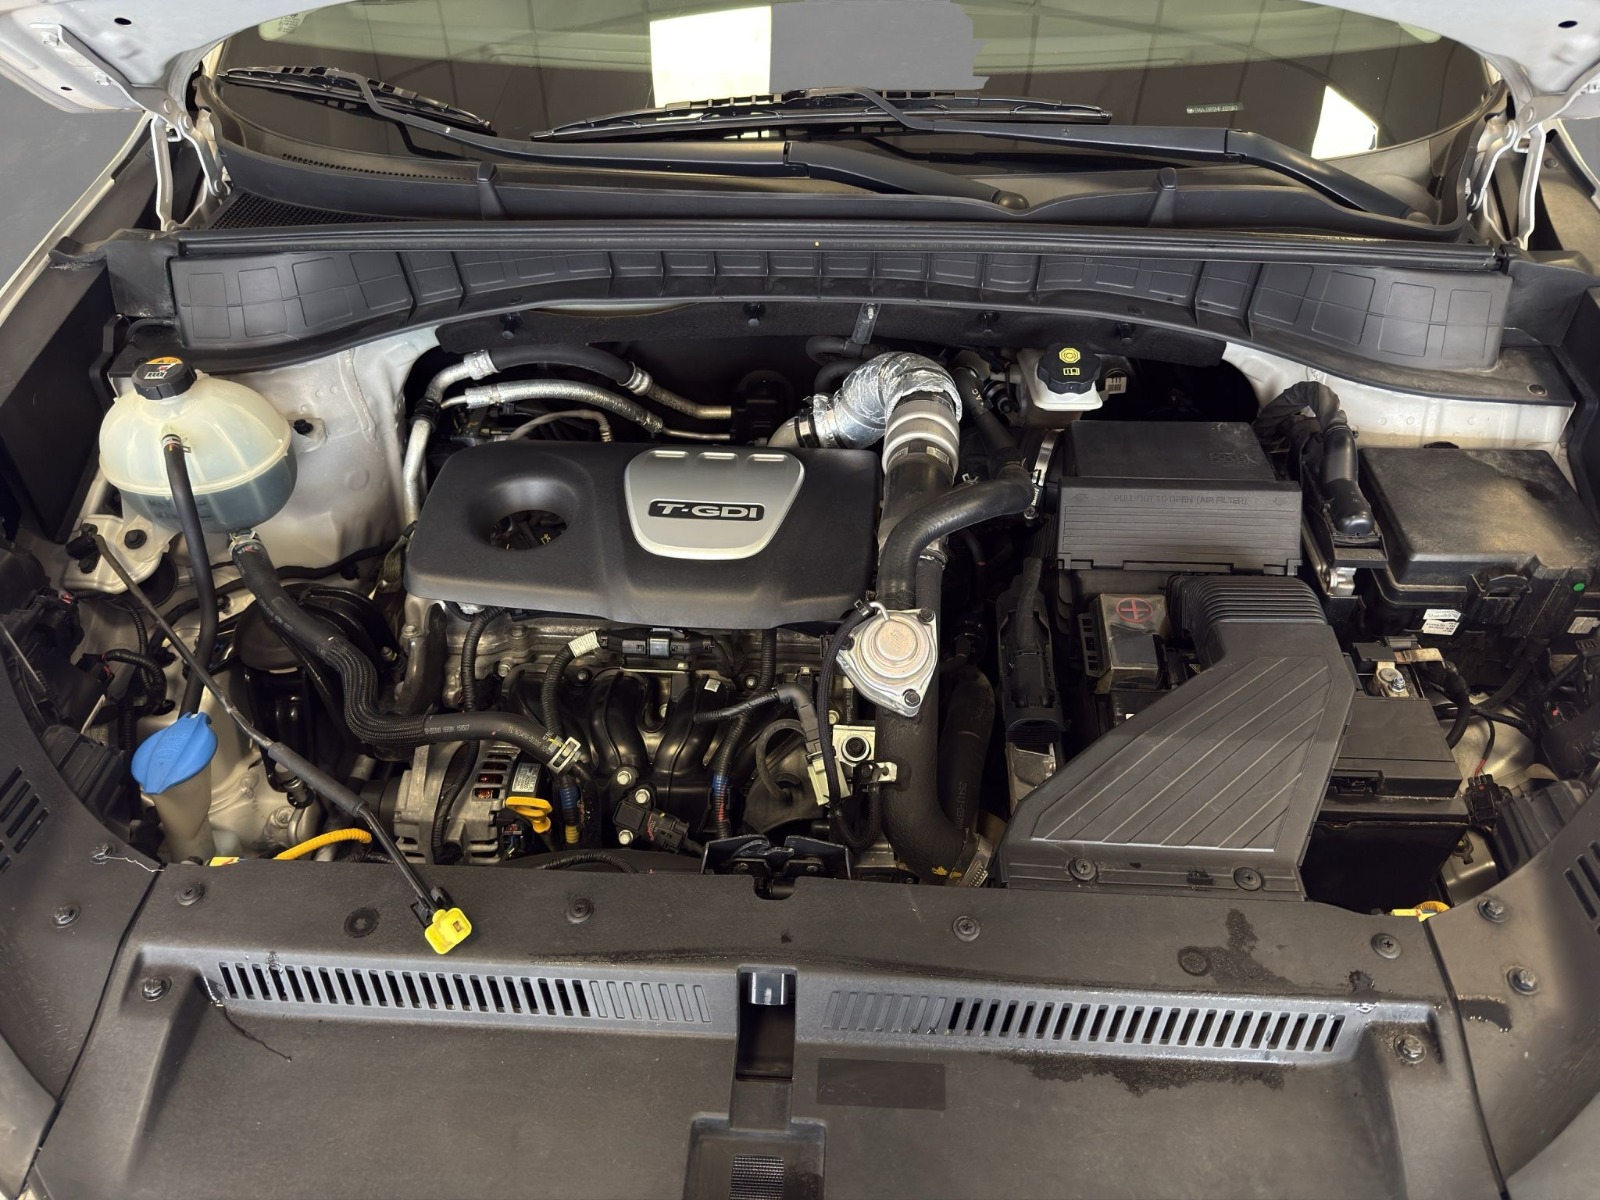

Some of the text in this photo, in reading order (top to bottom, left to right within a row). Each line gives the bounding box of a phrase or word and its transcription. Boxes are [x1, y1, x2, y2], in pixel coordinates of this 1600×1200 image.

[1114, 494, 1135, 503] PULL
[1136, 494, 1153, 503] OUT
[1156, 494, 1169, 503] TO
[1169, 495, 1193, 504] OPEN
[657, 503, 758, 519] T-GDI
